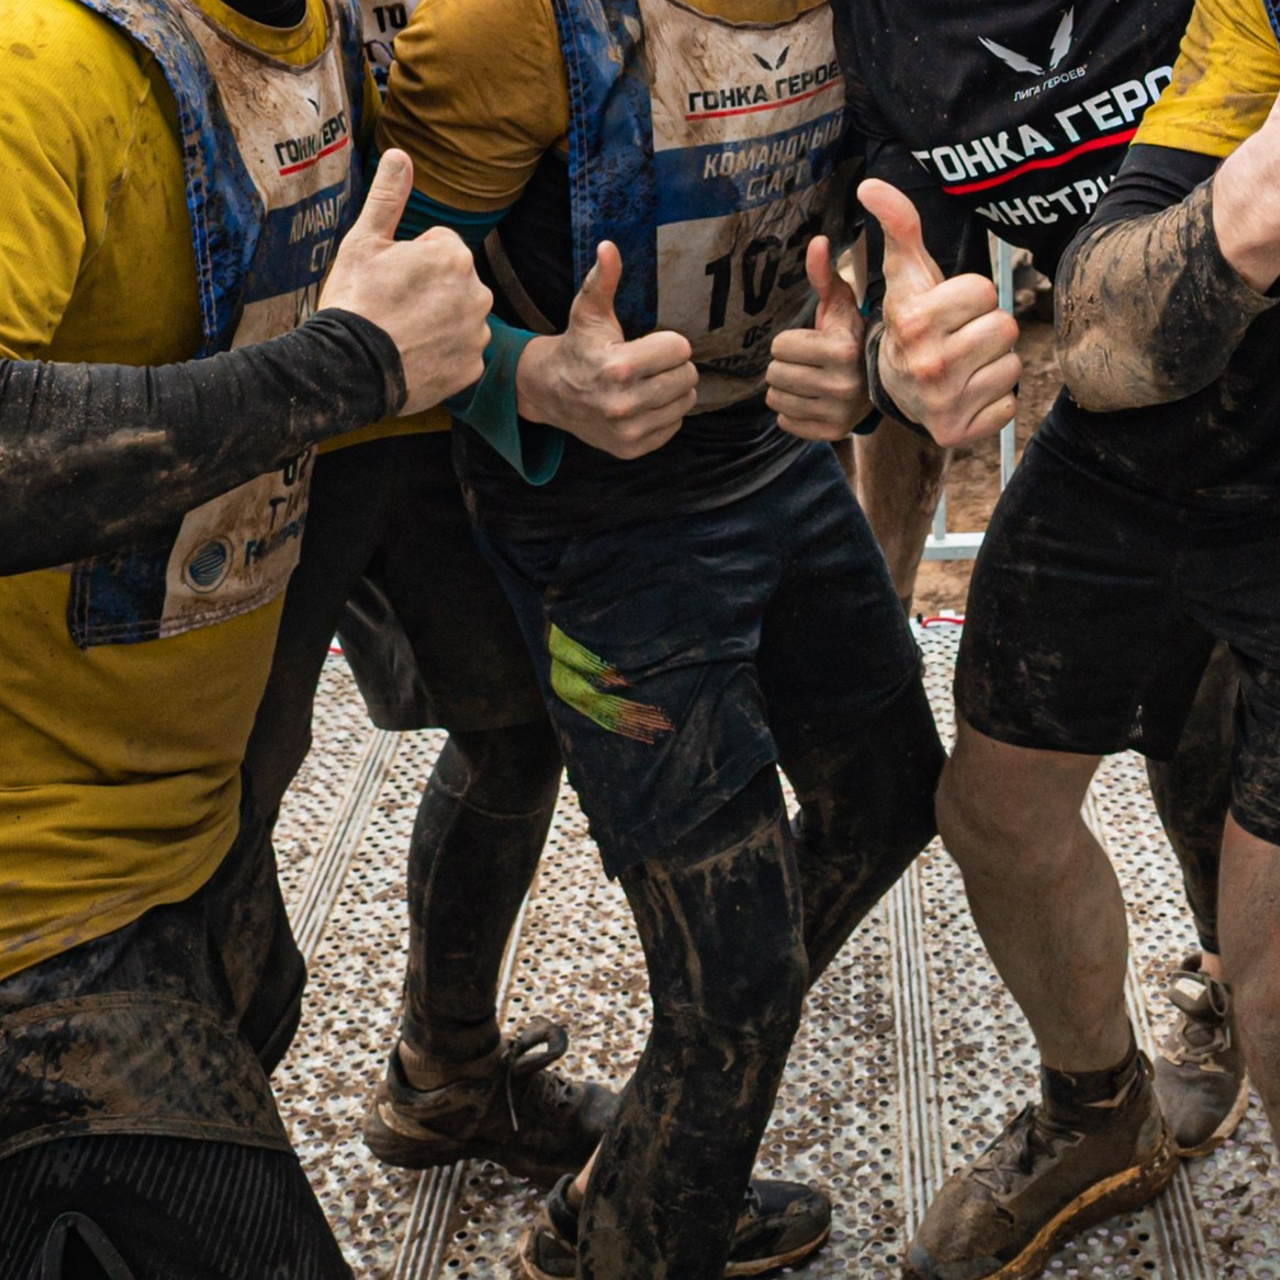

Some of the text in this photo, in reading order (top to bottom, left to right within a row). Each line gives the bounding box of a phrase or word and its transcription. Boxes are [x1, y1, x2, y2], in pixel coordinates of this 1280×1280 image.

[373, 5, 408, 33] 10
[688, 84, 768, 112] ГОНКА
[1013, 84, 1041, 102] ЛИГА
[703, 109, 844, 179] КОМАНДНЫЙ
[911, 124, 1055, 182] ГОНКА
